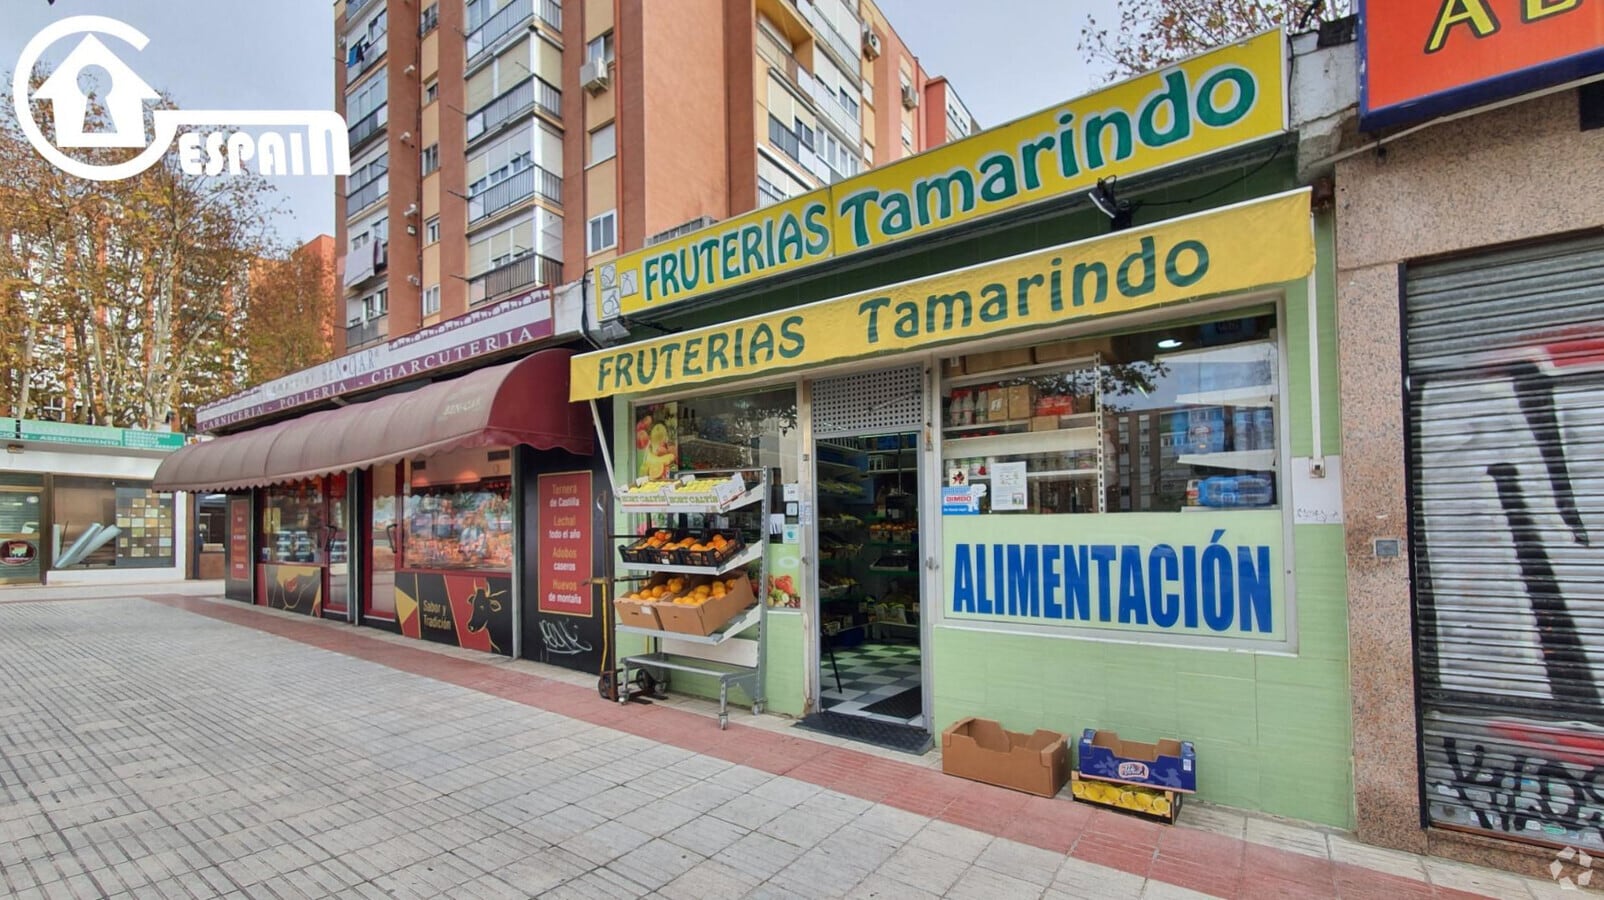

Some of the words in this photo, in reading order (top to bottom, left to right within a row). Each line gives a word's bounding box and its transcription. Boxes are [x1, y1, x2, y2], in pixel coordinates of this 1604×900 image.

[645, 203, 830, 301] FRUTERIAS
[841, 65, 1257, 248] Tamarindo
[597, 315, 806, 392] FRUTERIAS
[859, 236, 1211, 345] Tamarindo
[202, 405, 263, 430] CARNICERIA
[280, 382, 347, 409] POLLERIA
[371, 327, 534, 384] CHARCUTERIA
[552, 484, 577, 495] Ternera
[549, 499, 557, 507] de
[558, 497, 580, 507] Castilla
[553, 515, 576, 526] Lechal
[549, 530, 562, 539] todo
[562, 530, 569, 539] el
[552, 546, 577, 559] Adobos
[553, 563, 576, 571] caseros
[552, 580, 577, 592] Huevos
[953, 529, 1273, 633] ALIMENTACIÓN
[548, 592, 556, 602] de
[423, 600, 441, 613] Sabor
[423, 614, 451, 631] Tradición
